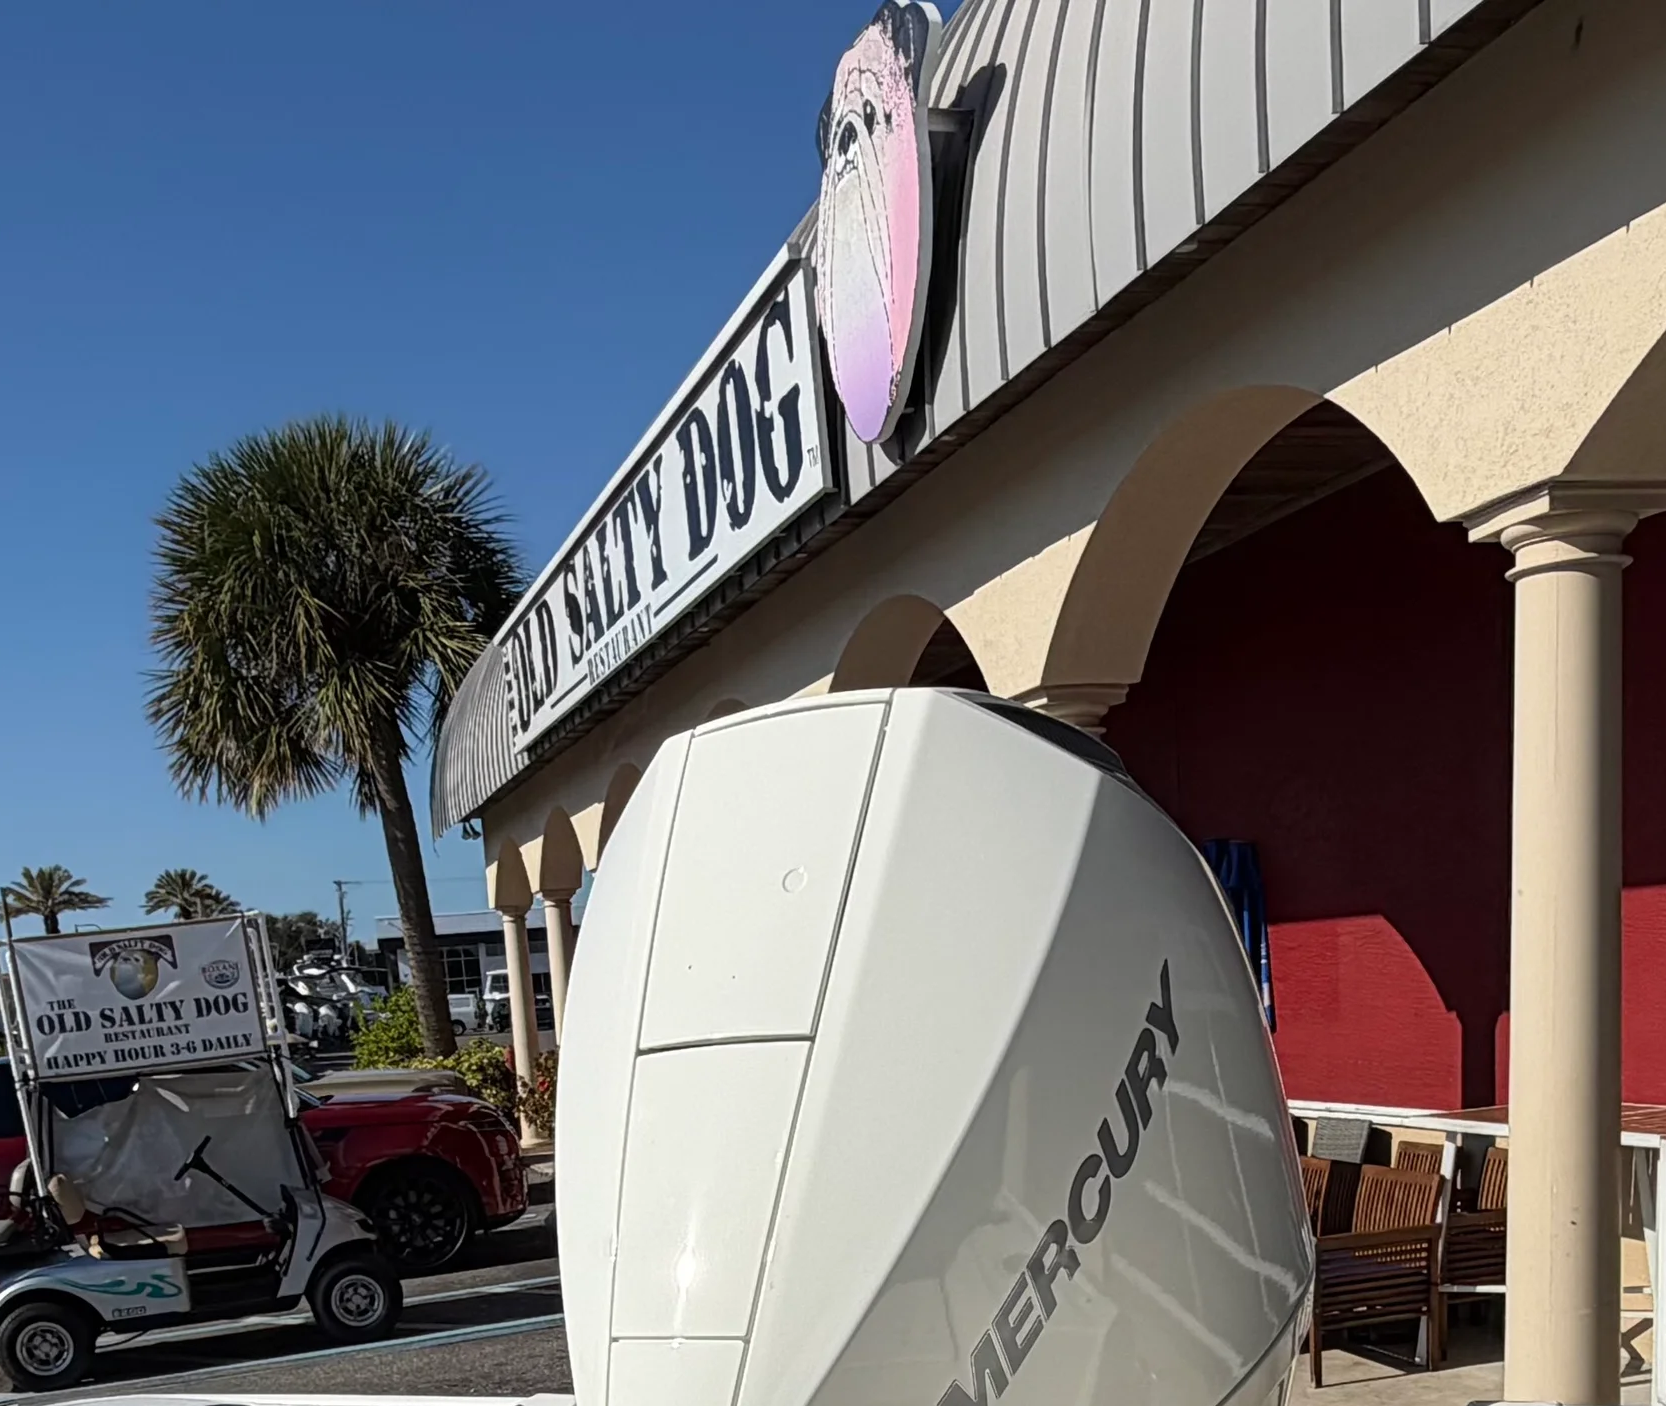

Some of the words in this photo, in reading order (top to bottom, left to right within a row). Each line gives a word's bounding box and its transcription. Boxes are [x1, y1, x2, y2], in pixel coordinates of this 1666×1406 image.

[511, 602, 560, 734] OLD
[563, 454, 668, 669] SALTY
[676, 285, 804, 562] DOG
[587, 604, 654, 686] RESTAURANT
[36, 1011, 92, 1036] OLD
[100, 1000, 185, 1030] SALTY
[193, 992, 249, 1019] DOG
[47, 999, 76, 1012] THE
[46, 1050, 107, 1071] HAPPY
[114, 1045, 166, 1063] HOUR
[170, 1039, 198, 1055] 3-6
[202, 1033, 253, 1052] DAILY
[104, 1024, 191, 1043] RESTAURANT
